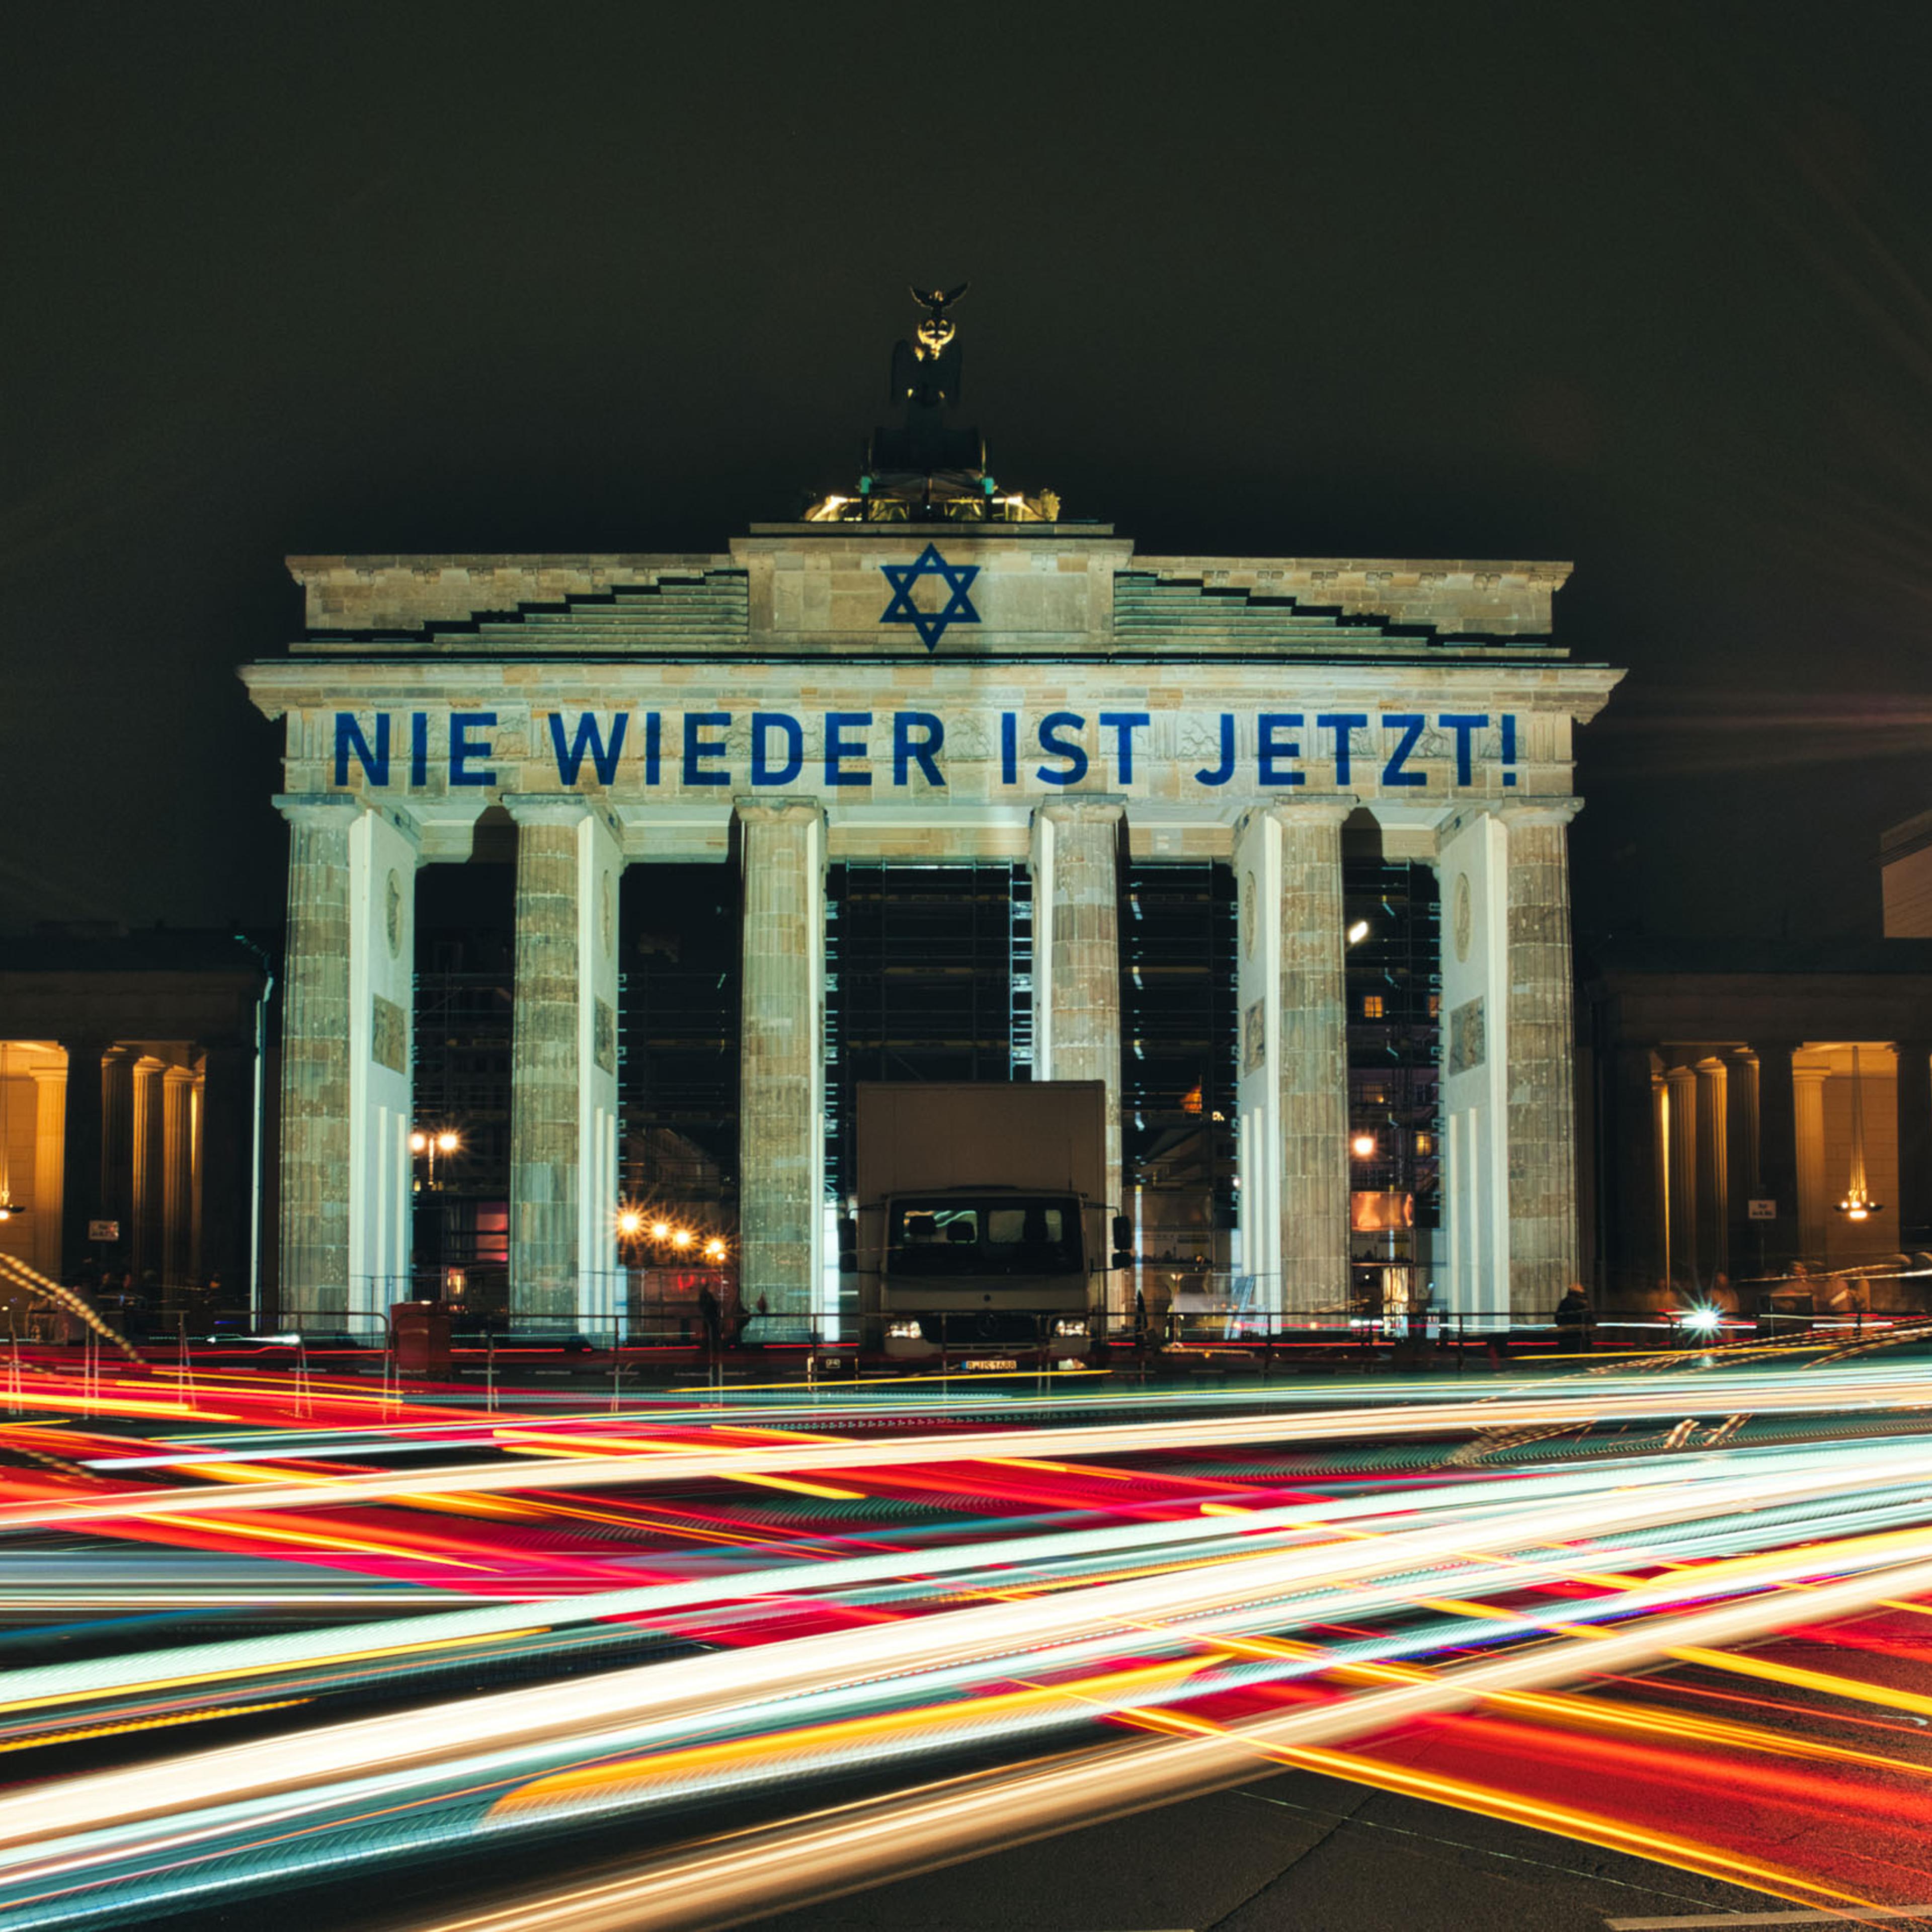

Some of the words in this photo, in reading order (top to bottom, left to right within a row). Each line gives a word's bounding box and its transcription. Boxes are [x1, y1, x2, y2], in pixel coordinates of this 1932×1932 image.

[334, 712, 498, 786] NIE
[548, 711, 944, 786] WIEDER
[1000, 711, 1151, 786] IST
[1194, 713, 1516, 786] JETZT!
